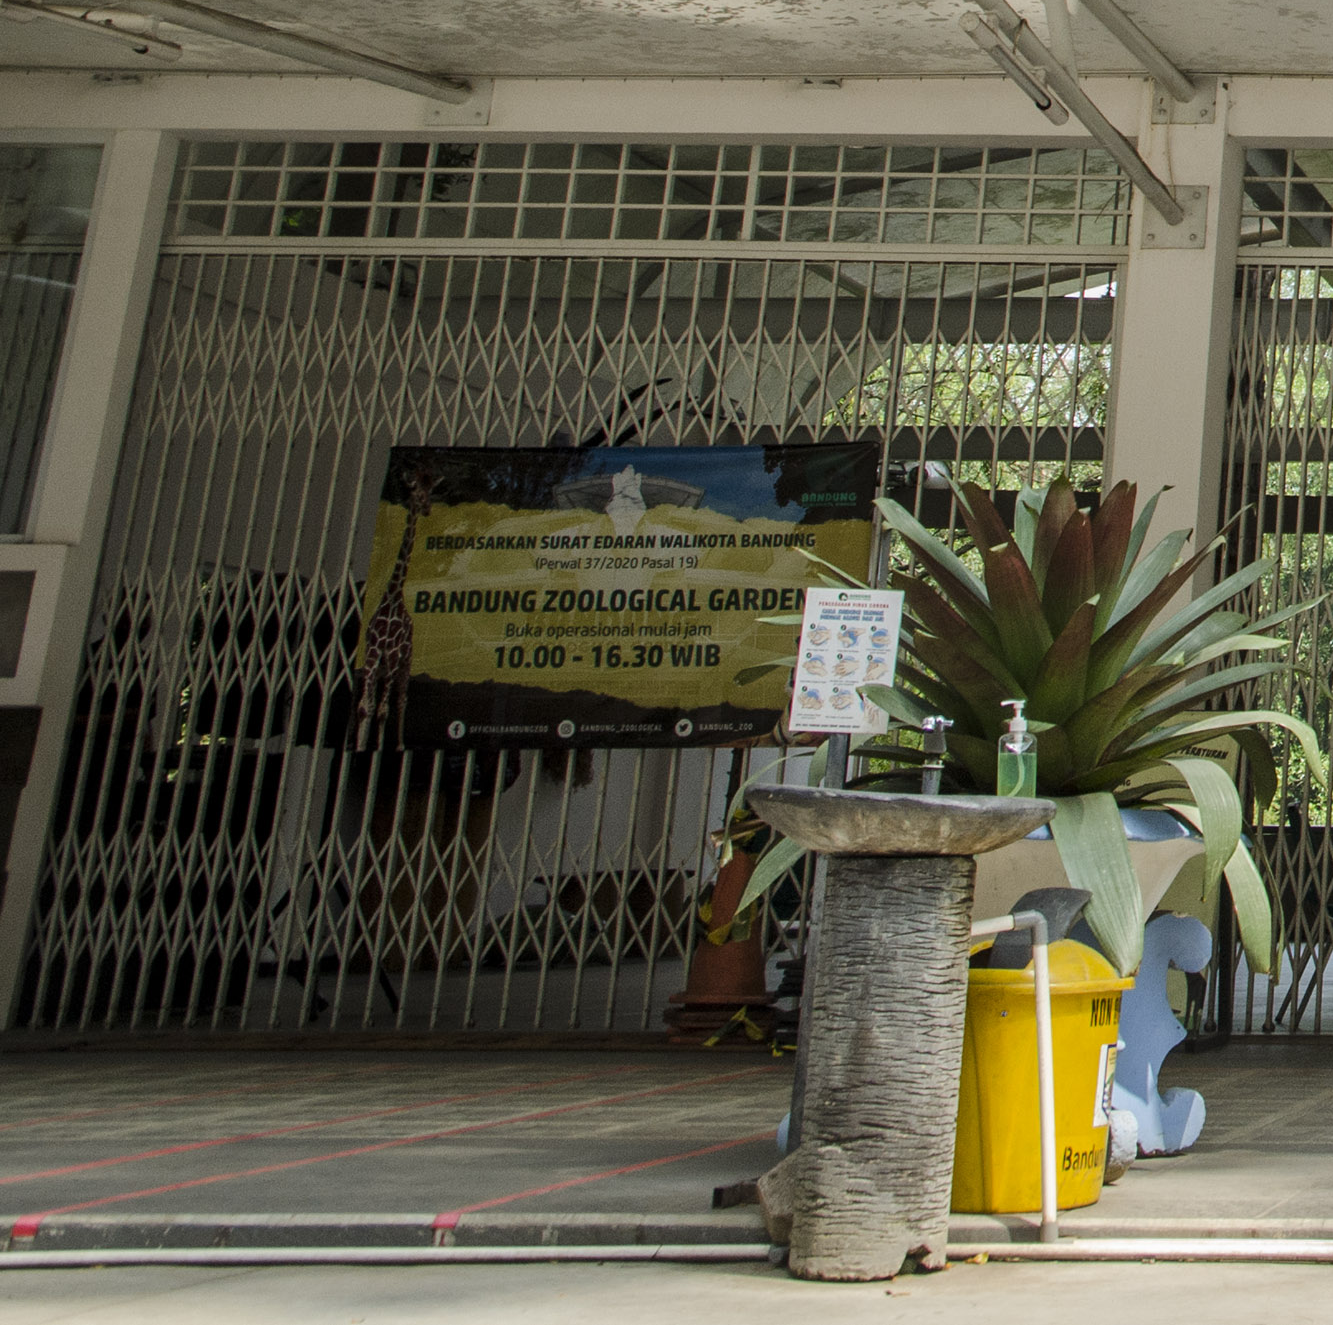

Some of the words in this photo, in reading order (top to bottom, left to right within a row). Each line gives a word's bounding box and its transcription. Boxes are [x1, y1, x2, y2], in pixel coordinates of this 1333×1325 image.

[801, 492, 857, 502] BANDUNG
[426, 535, 537, 550] BERDASARKAN
[540, 535, 591, 549] SURAT
[593, 535, 657, 549] EDARAN
[660, 533, 737, 549] WALIKOTA
[741, 533, 816, 548] BANDUNG
[535, 557, 582, 570] (Perwal
[584, 557, 639, 570] 37/2020
[641, 556, 674, 569] Pasal
[677, 556, 699, 569] 19)
[414, 589, 536, 614] BANDUNG
[541, 589, 701, 613] ZOOLOGICAL
[505, 622, 543, 638] Buka
[546, 622, 635, 640] operasional
[638, 621, 682, 637] mulai
[683, 622, 712, 640] jam
[494, 645, 566, 669] 10.00
[591, 645, 664, 669] 16.30
[670, 644, 721, 667] WIB
[1090, 997, 1113, 1027] NON
